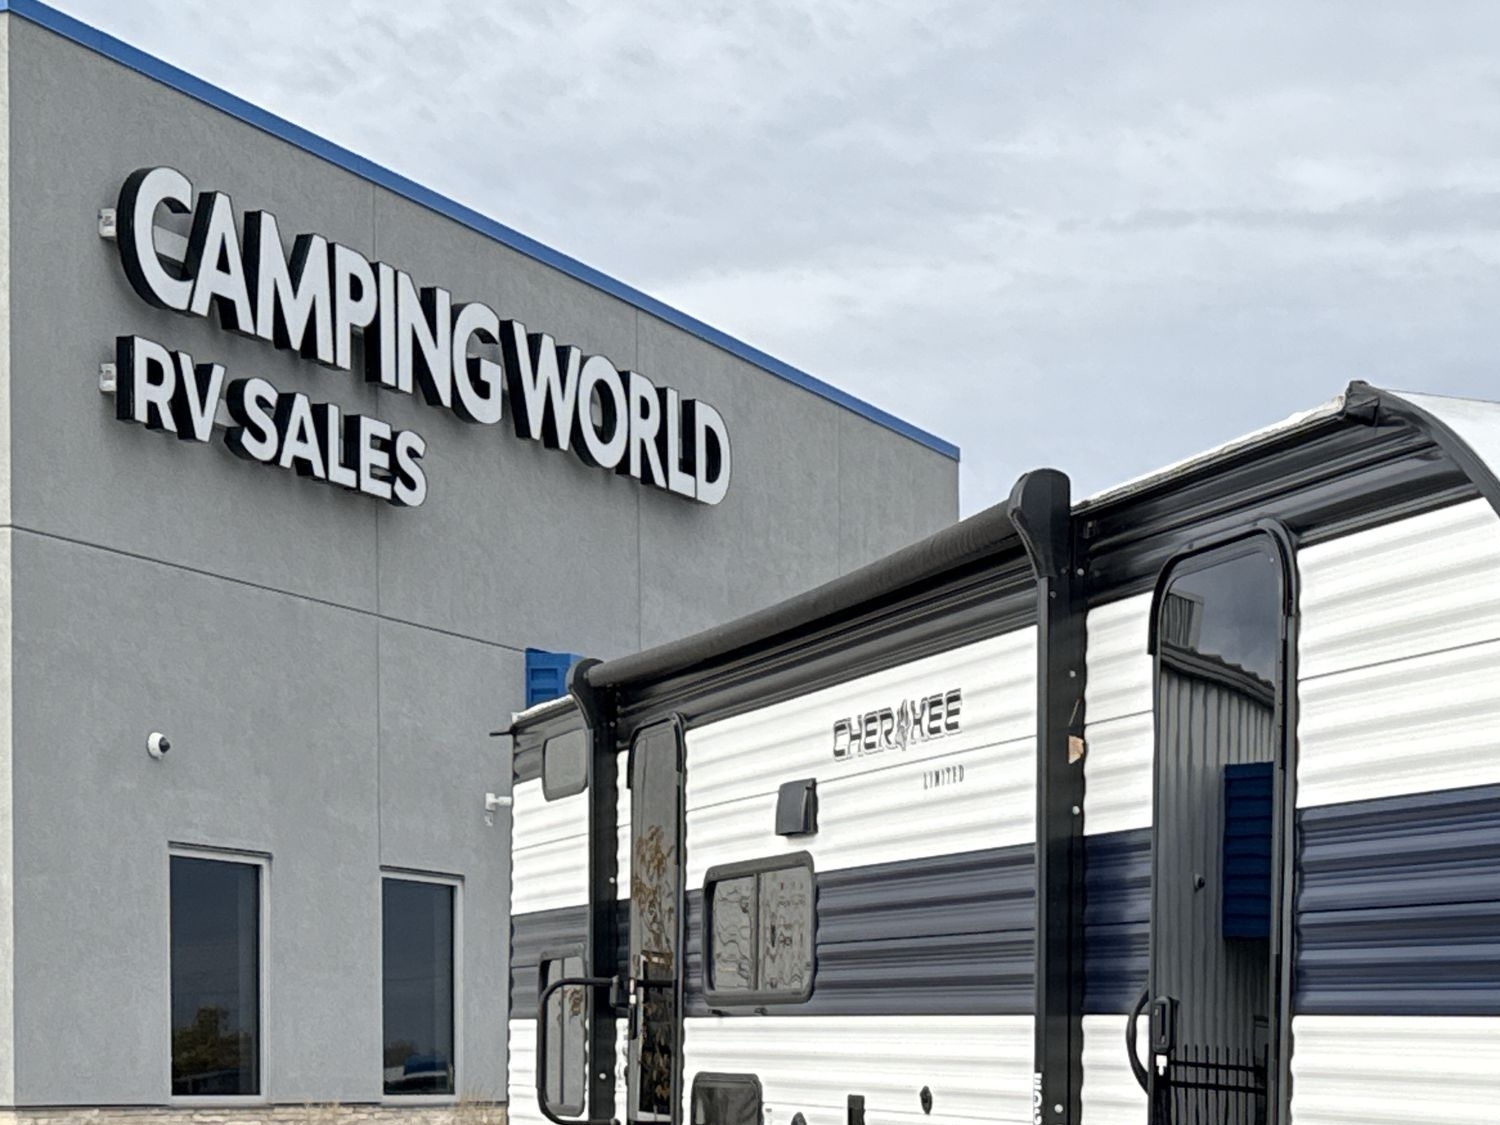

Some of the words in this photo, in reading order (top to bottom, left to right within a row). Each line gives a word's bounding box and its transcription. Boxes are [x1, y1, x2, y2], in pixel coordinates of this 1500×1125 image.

[116, 166, 501, 424] CAMPING
[500, 318, 731, 505] WORLD
[116, 335, 226, 442] RV
[225, 376, 428, 507] SALES
